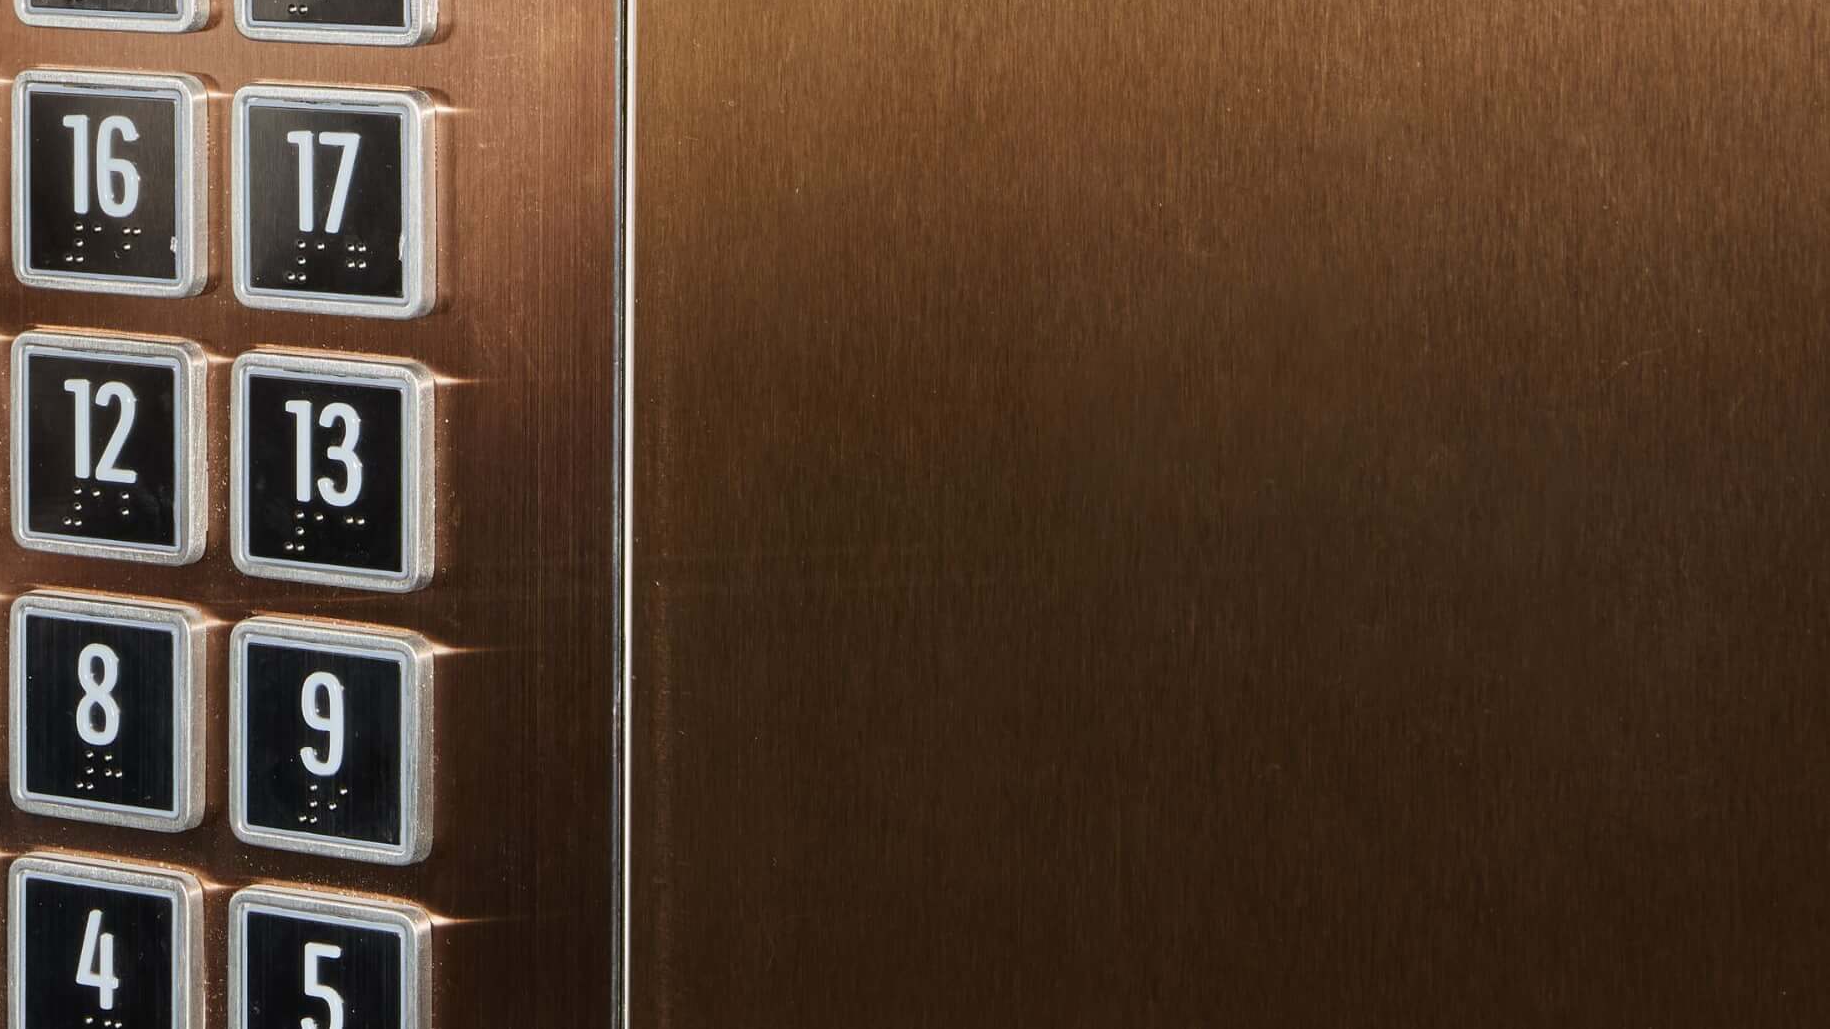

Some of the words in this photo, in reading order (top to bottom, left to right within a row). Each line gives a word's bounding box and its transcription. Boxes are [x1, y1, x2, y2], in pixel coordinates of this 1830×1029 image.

[63, 114, 140, 217] 16
[287, 130, 361, 234] 17
[63, 378, 137, 483] 12
[285, 400, 362, 507] 13
[76, 643, 119, 745] 8
[300, 671, 345, 775] 9
[76, 909, 118, 1010] 4
[303, 942, 342, 1029] 5
